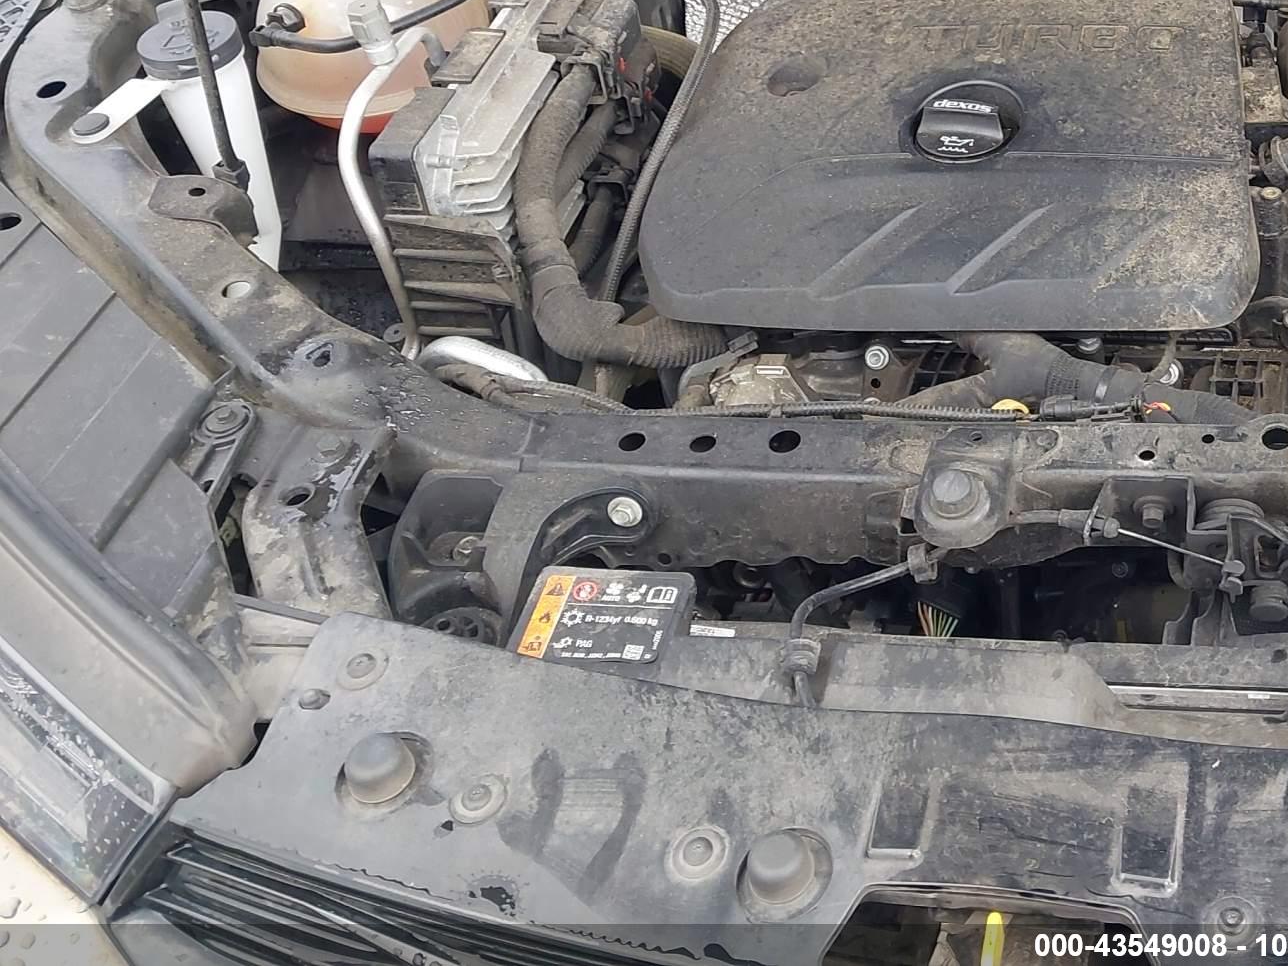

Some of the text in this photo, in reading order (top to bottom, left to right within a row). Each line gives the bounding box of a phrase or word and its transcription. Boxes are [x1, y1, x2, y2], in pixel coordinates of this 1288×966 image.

[912, 24, 1186, 52] TURBO
[933, 99, 993, 113] dexos
[601, 594, 621, 602] AUTO
[584, 615, 622, 625] R-1234yf
[647, 617, 659, 626] kg
[575, 639, 593, 648] PAG
